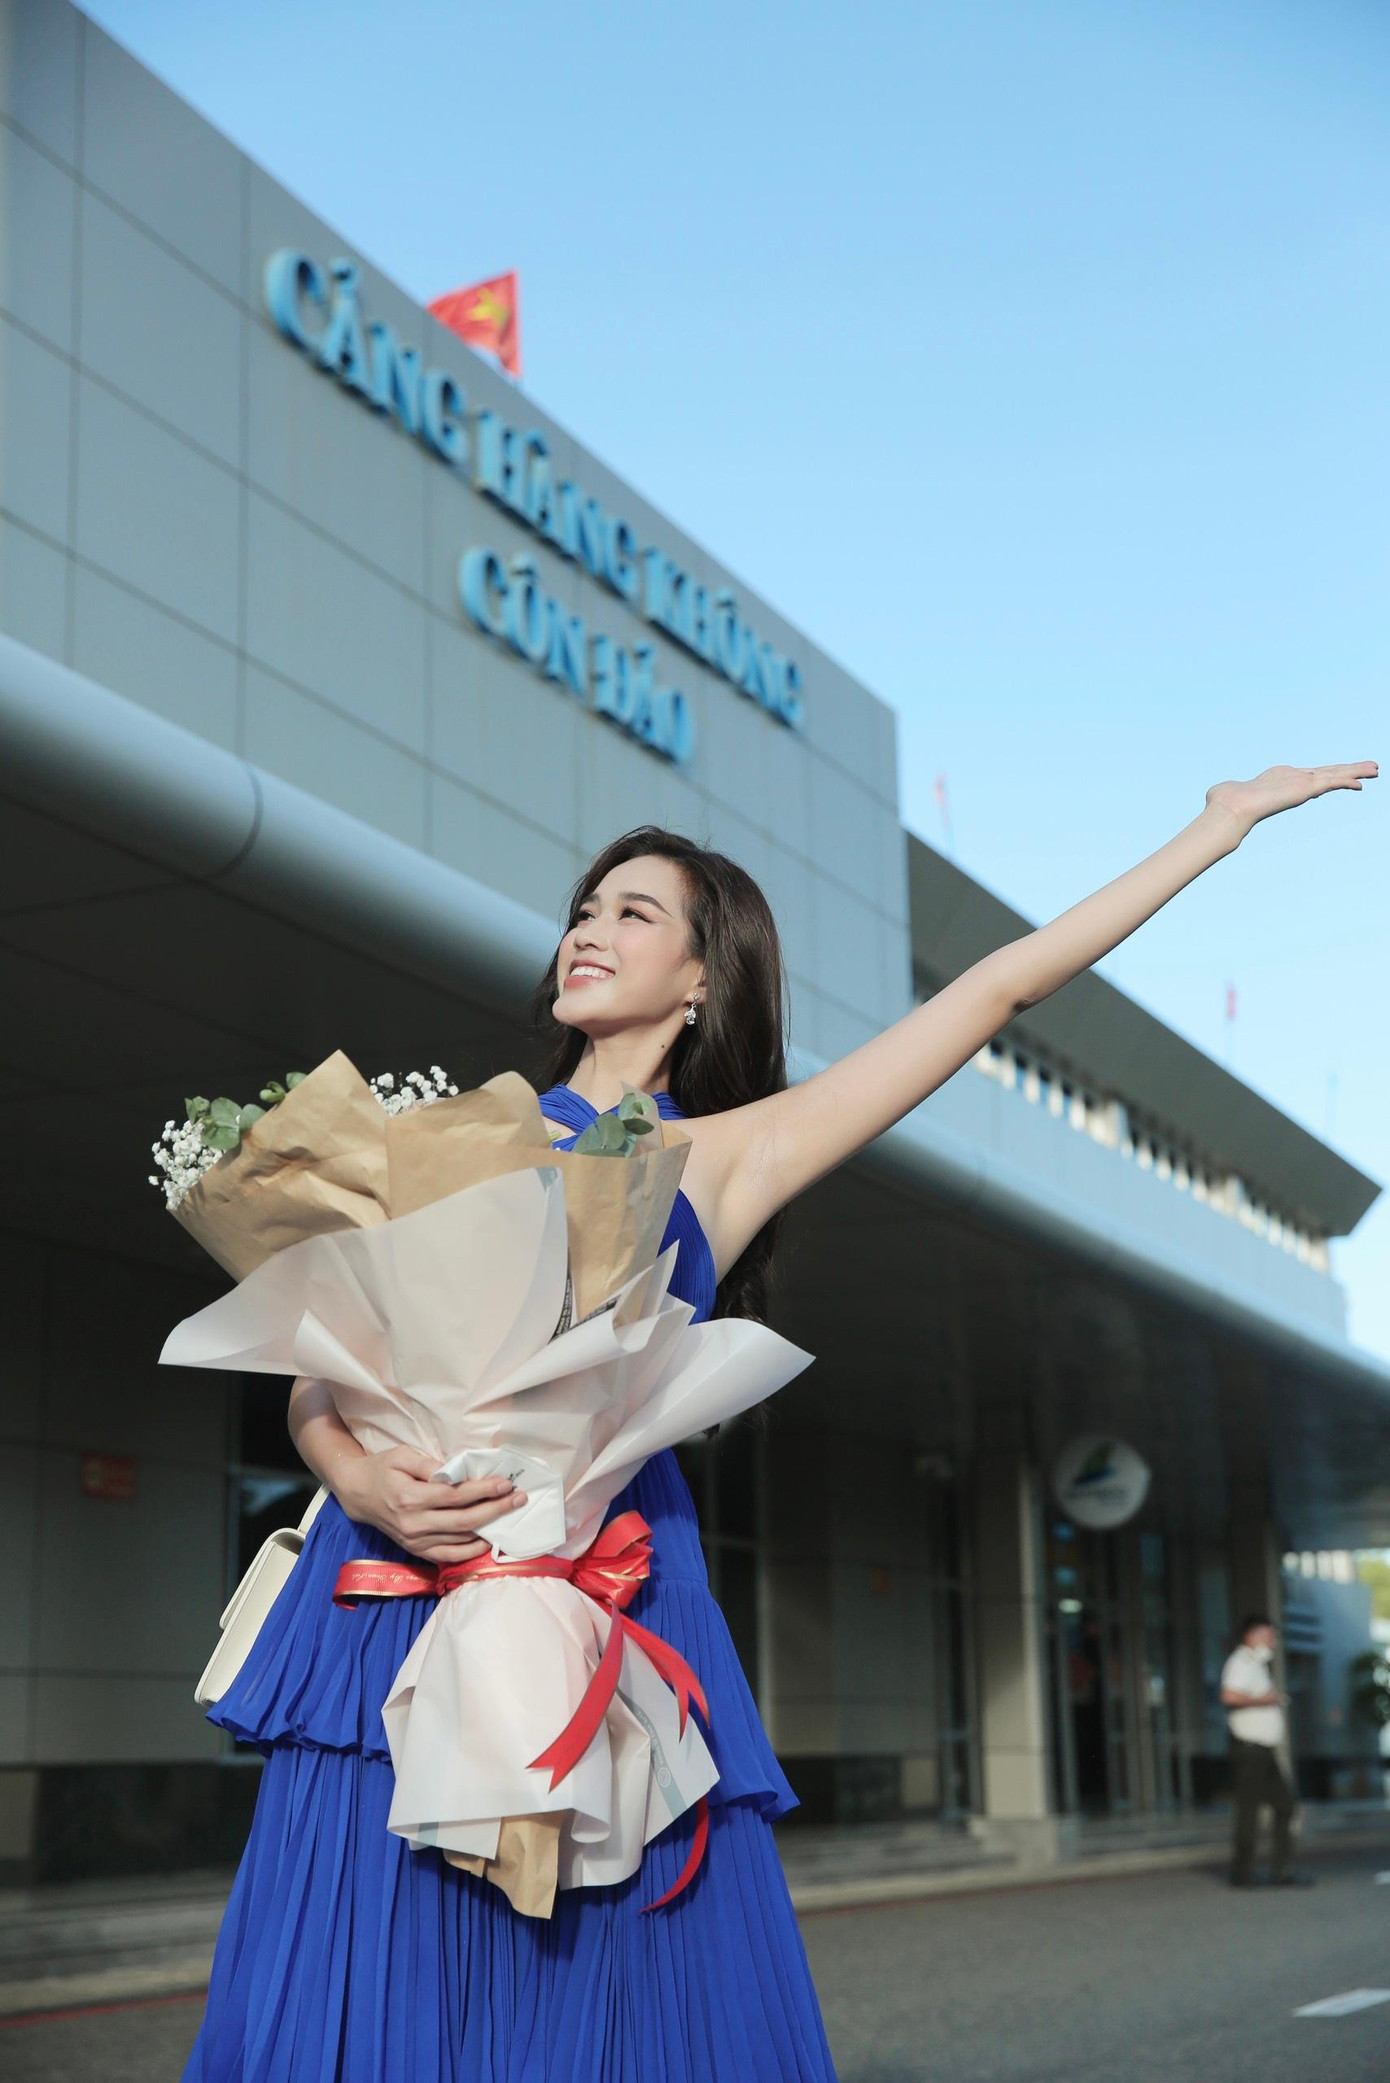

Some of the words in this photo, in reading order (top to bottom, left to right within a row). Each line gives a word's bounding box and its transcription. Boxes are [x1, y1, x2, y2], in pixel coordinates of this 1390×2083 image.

[264, 247, 470, 466] CẢNG
[640, 546, 802, 729] KHÔNG
[459, 548, 587, 697] CÔN
[590, 634, 693, 768] ĐẢO
